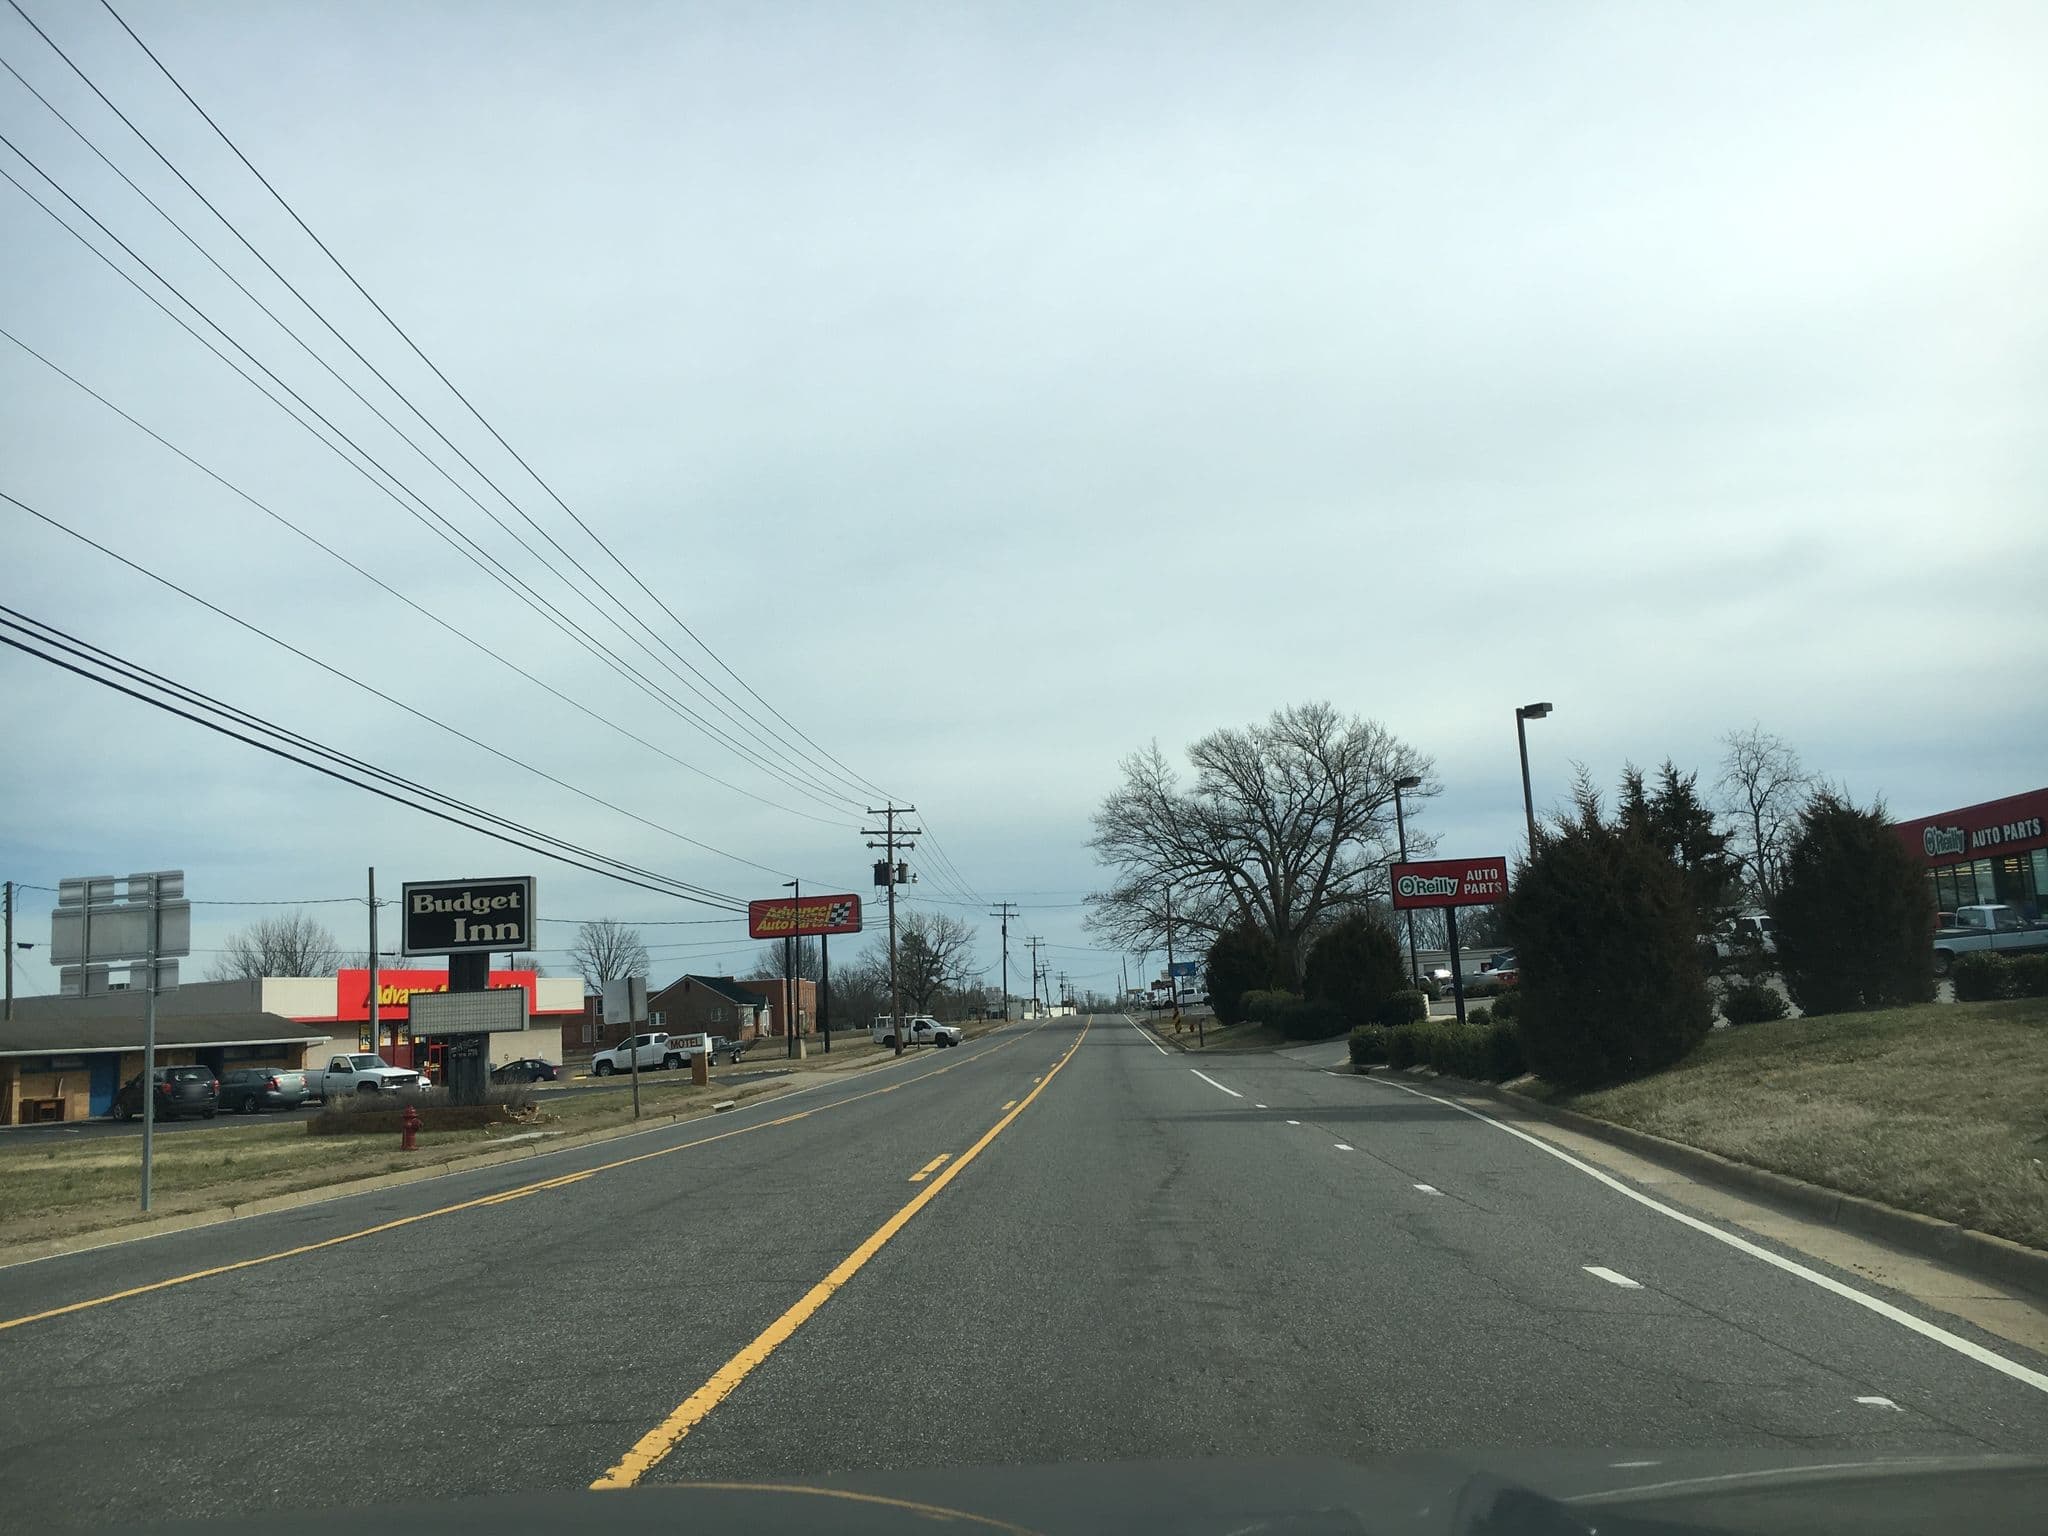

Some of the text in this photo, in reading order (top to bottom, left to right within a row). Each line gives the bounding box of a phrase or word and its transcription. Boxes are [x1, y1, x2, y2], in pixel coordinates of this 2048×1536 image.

[1972, 827, 2000, 848] AUTO
[2003, 818, 2041, 841] PARTS
[1466, 868, 1498, 881] AUTO
[1399, 876, 1458, 896] O'Reilly
[1464, 882, 1502, 895] PARTS
[412, 892, 520, 914] Budget
[453, 918, 520, 942] Inn
[670, 1037, 703, 1050] MOTEL
